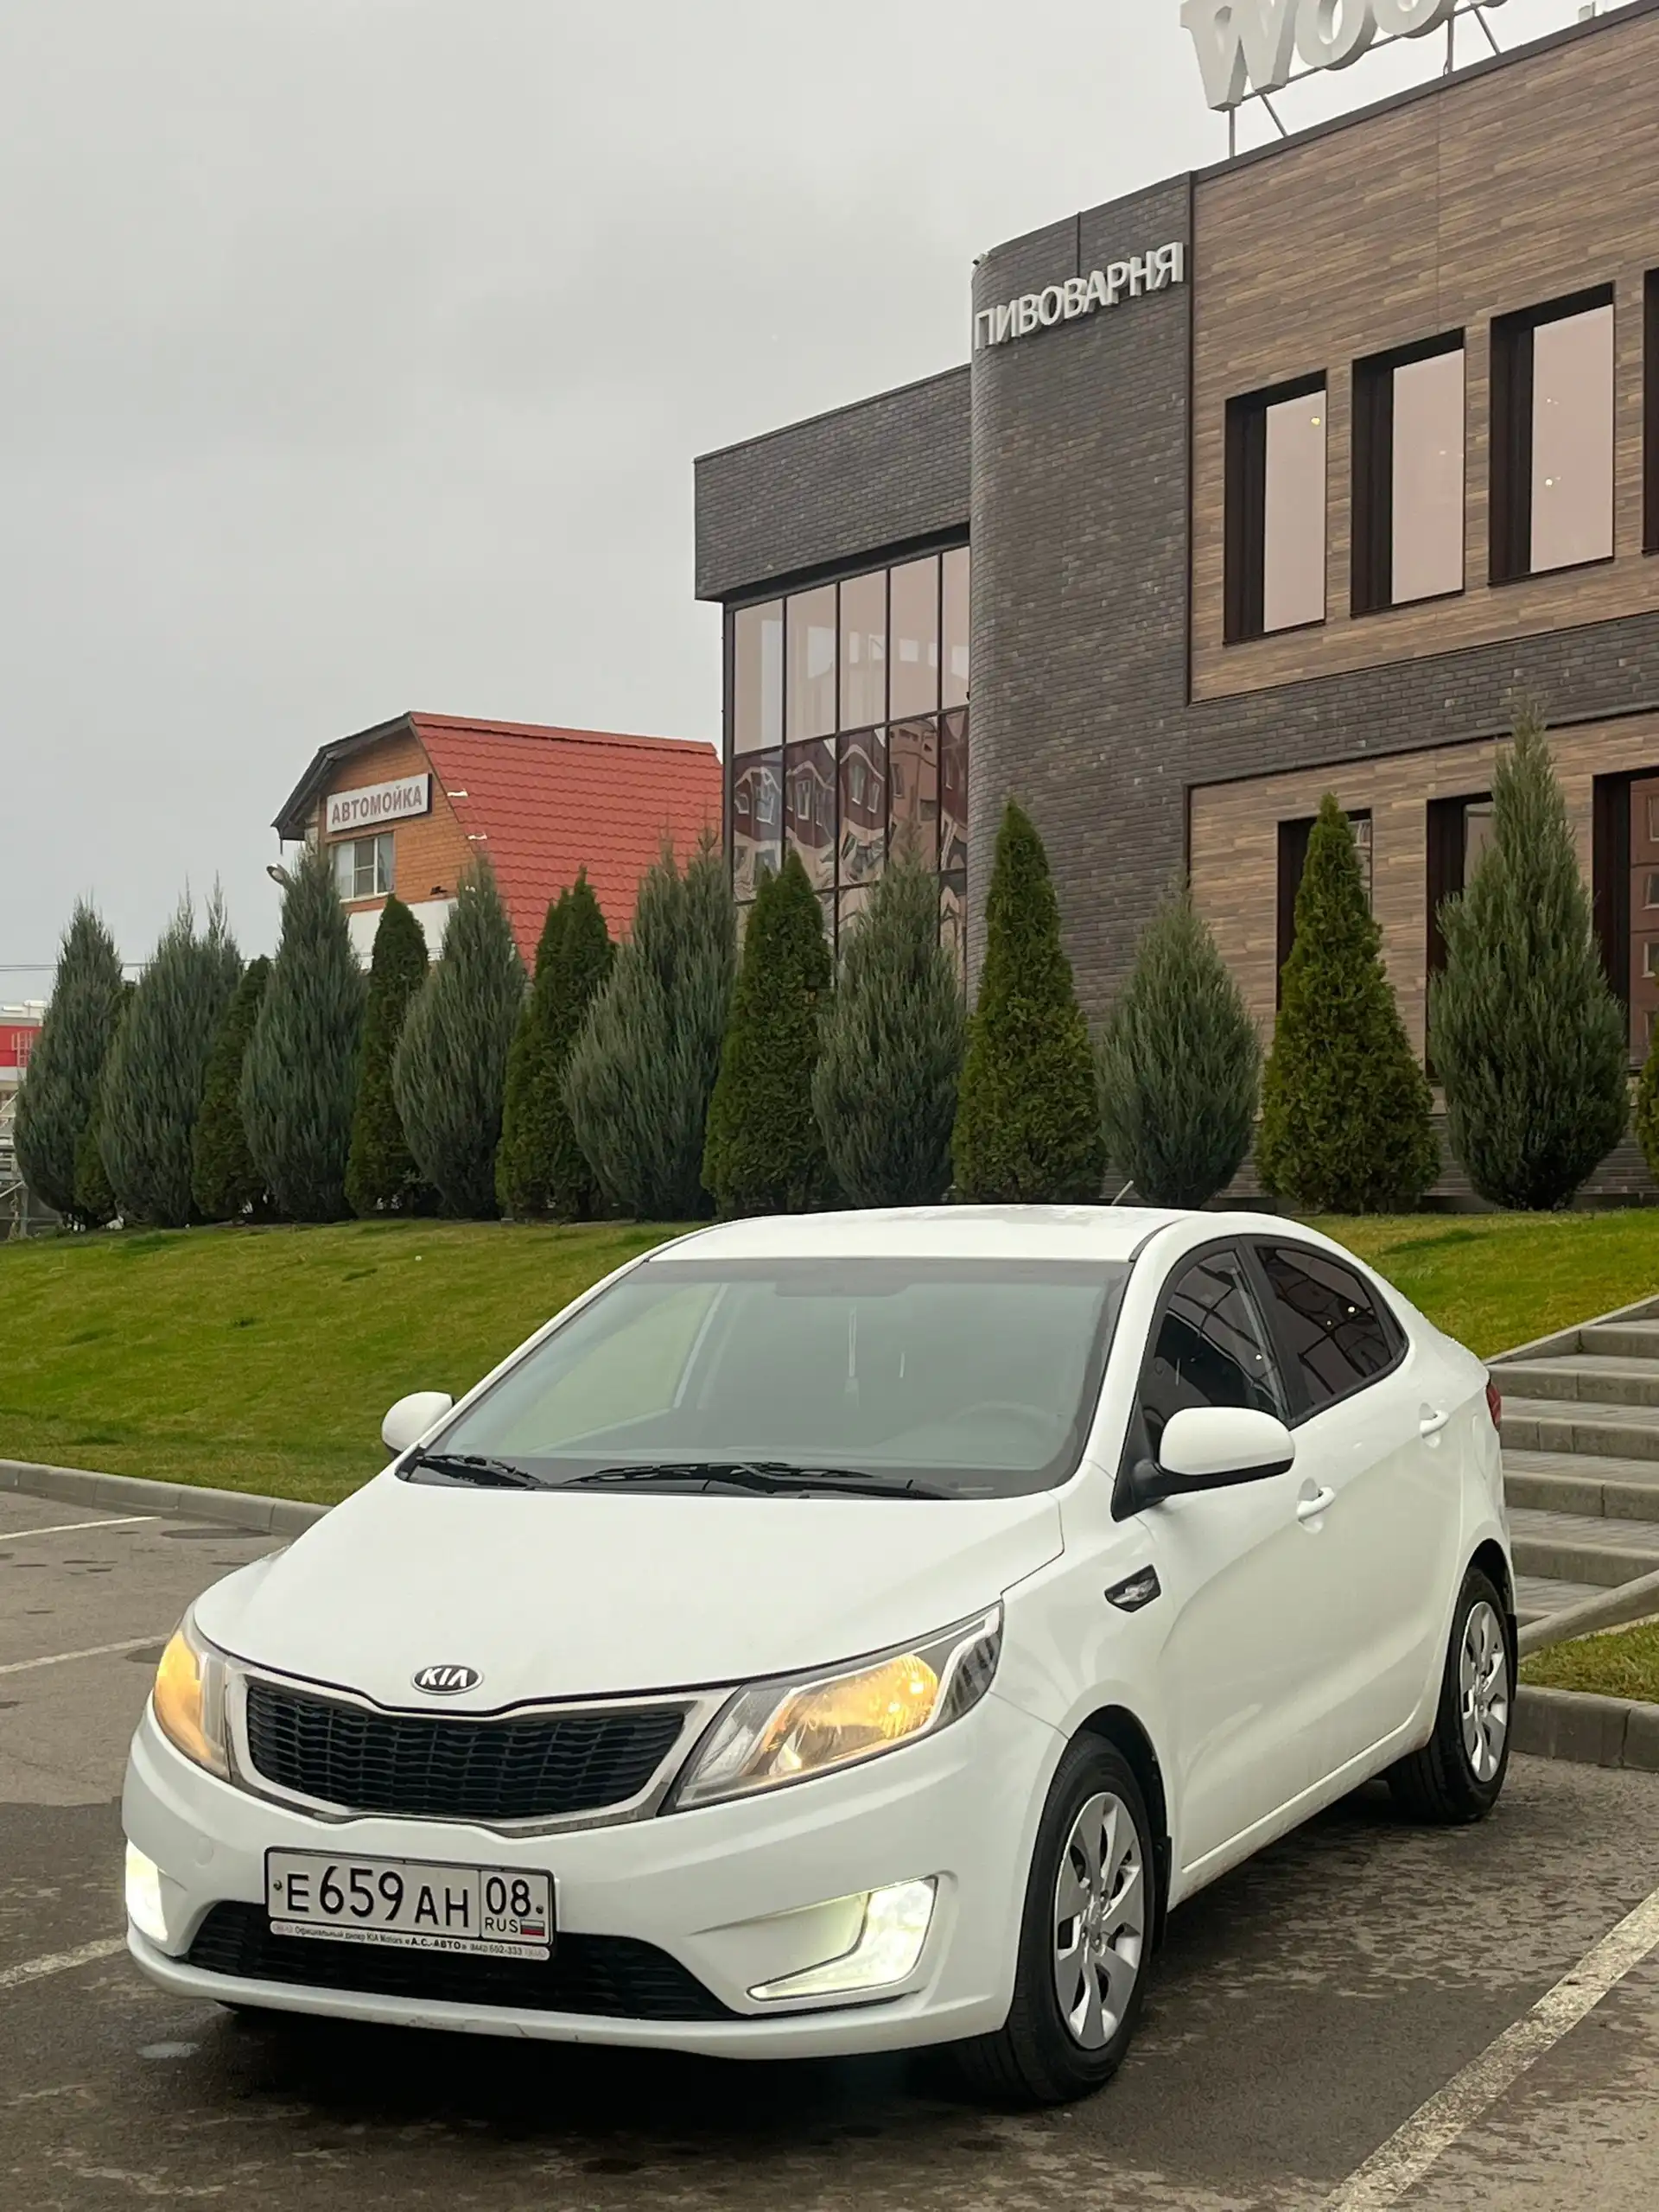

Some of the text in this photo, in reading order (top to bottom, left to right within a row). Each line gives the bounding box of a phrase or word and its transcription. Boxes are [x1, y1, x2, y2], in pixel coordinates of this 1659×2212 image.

[975, 242, 1184, 350] ПИВОВАРНЯ
[331, 785, 423, 824] АВТОМОЙКА
[420, 1668, 468, 1688] KIA
[486, 1876, 531, 1917] 08
[485, 1916, 518, 1934] RUS
